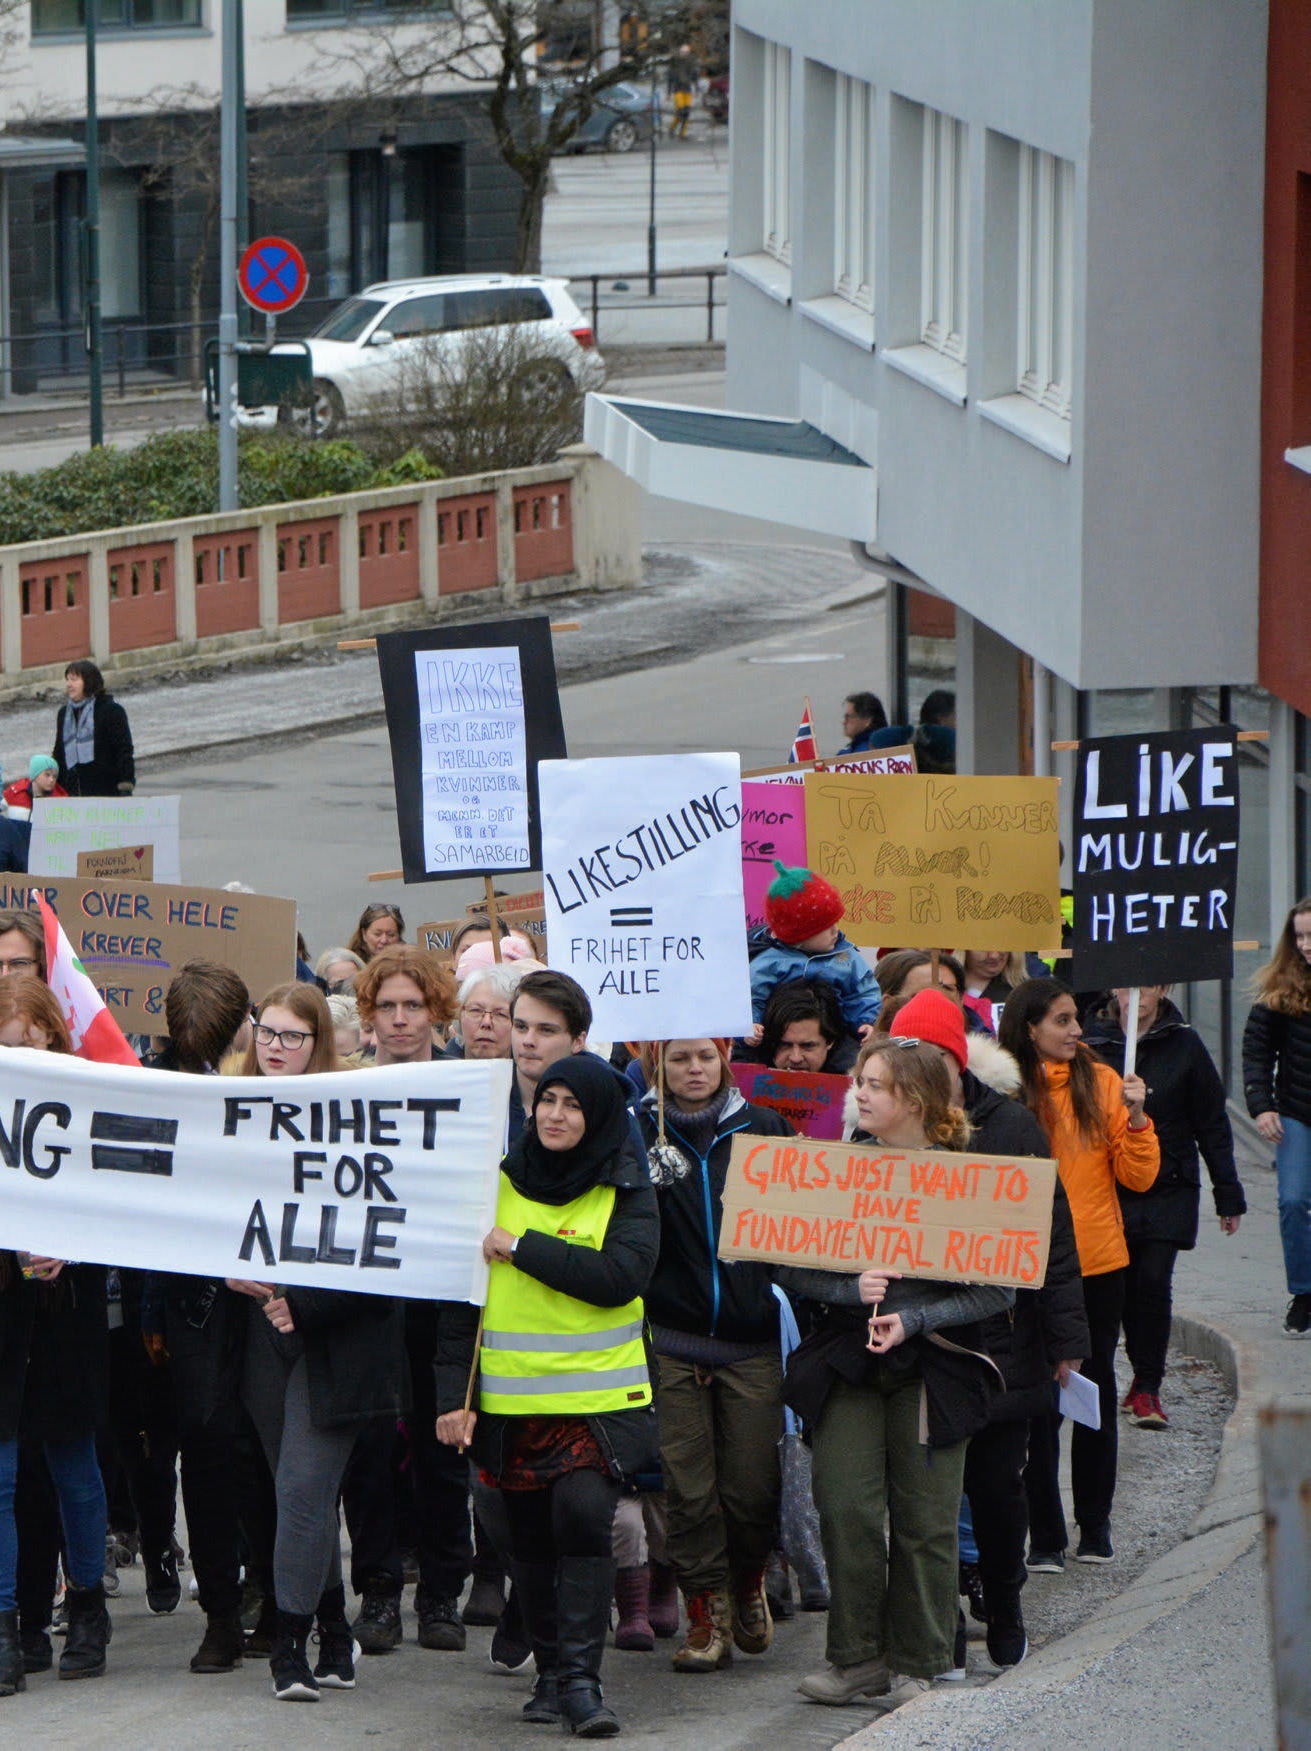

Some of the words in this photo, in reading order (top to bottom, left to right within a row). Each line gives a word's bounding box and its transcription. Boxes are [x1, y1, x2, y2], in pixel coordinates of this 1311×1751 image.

[427, 660, 522, 714] IKKE
[425, 723, 460, 744] EN
[466, 721, 516, 742] KAMP
[438, 750, 512, 769] MELLOM
[436, 775, 520, 793] KVINNER
[488, 807, 514, 822] DET
[925, 779, 1057, 834] KVINNER
[455, 825, 472, 839] ER
[546, 786, 740, 914] LIKESTILLING
[1078, 829, 1237, 873] MULIG-
[434, 843, 529, 864] SAMARBEID
[81, 889, 153, 920] OVER
[166, 899, 238, 931] HELE
[1093, 889, 1228, 941] HETER
[80, 930, 162, 958] KREVER
[571, 937, 652, 964] FRIHET
[662, 936, 705, 962] FOR
[598, 969, 660, 995] ALLE
[223, 1096, 461, 1150] FRIHET
[292, 1151, 398, 1202] FOR
[743, 1143, 831, 1194] GIRLS
[835, 1154, 905, 1191] JUST
[910, 1161, 991, 1199] WANT
[993, 1164, 1029, 1202] TO
[852, 1193, 921, 1224] HAVE
[238, 1198, 406, 1269] ALLE
[732, 1208, 933, 1270] FUNDAMENTAL
[944, 1228, 1041, 1282] RIGHTS
